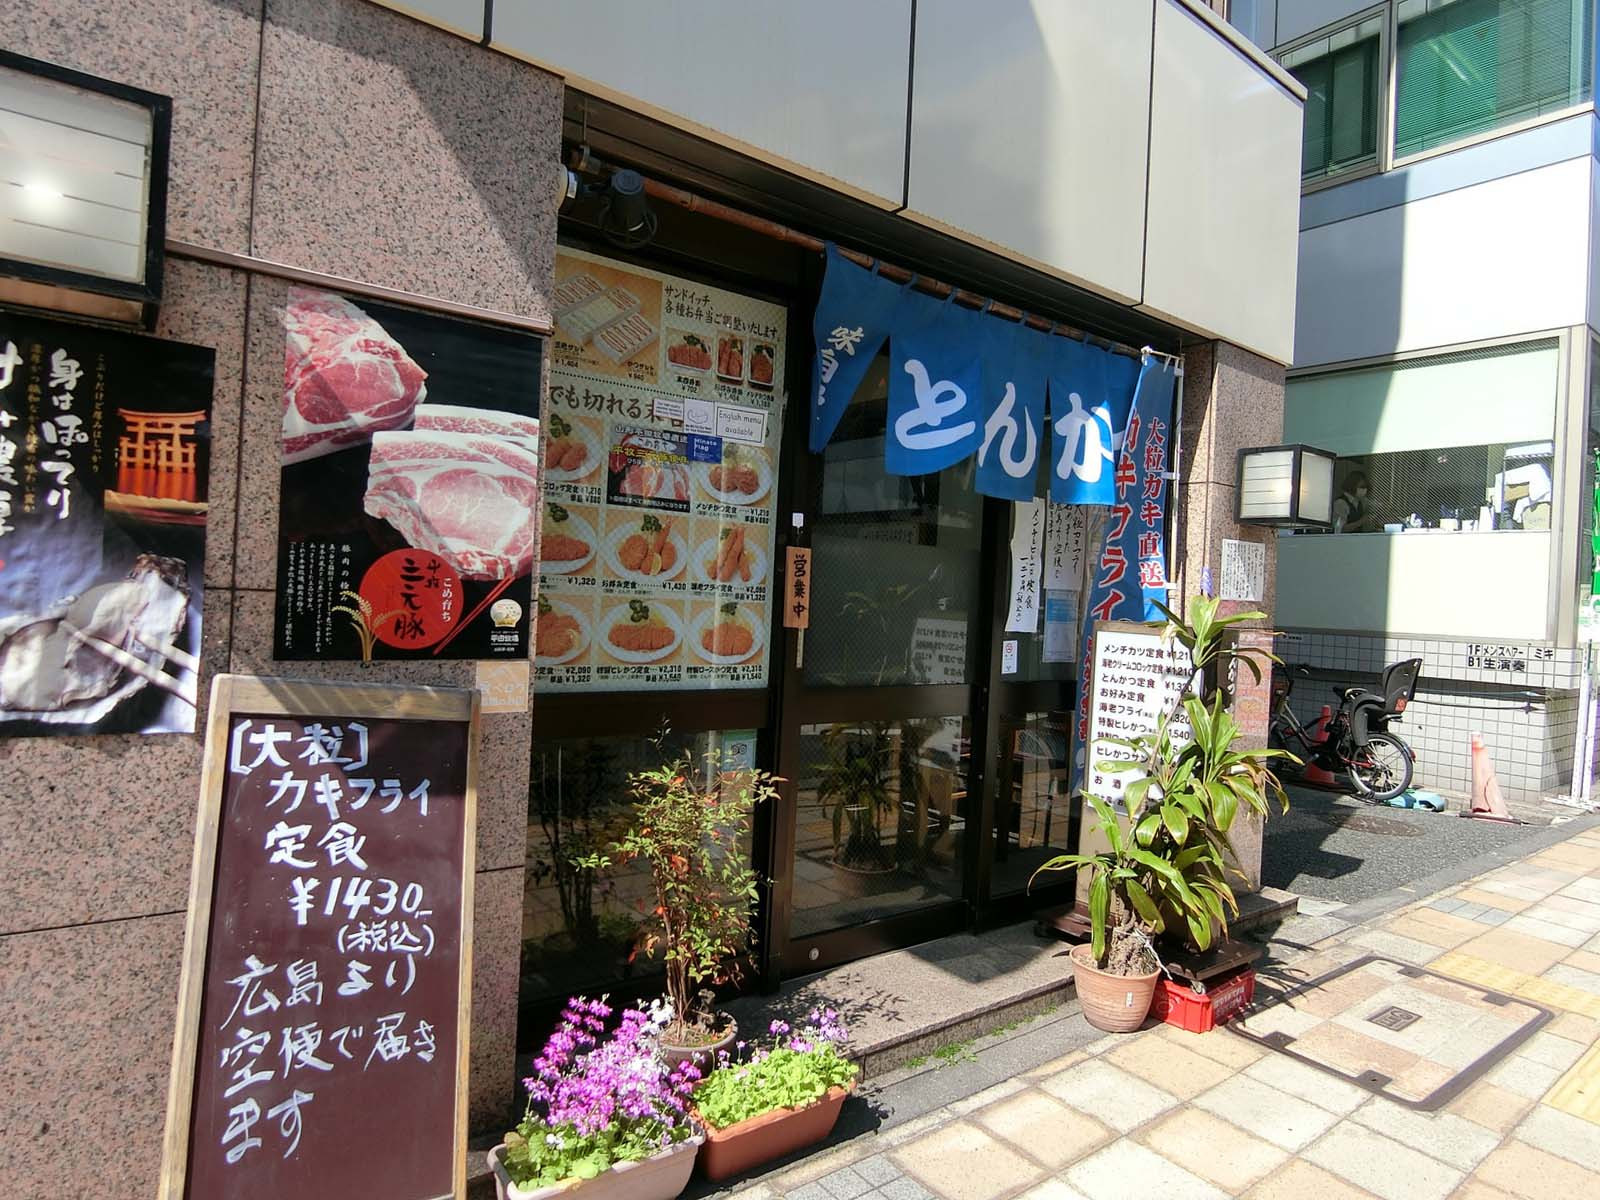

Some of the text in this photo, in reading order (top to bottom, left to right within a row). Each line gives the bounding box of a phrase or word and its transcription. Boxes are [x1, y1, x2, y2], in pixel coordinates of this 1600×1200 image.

[41, 347, 89, 520] 身はぽってり
[718, 409, 763, 426] English menu
[724, 425, 754, 437] available
[895, 359, 1126, 484] とんか
[1091, 408, 1141, 621] カキフライ
[1138, 416, 1167, 589] 大粒カキ直送
[394, 557, 426, 640] 三元豚
[441, 577, 454, 623] こめ育ち
[567, 576, 597, 587] ¥1,320
[601, 579, 638, 590] お好み定食
[792, 554, 807, 618] 営業中
[1101, 658, 1163, 675] 海老クリームコロッケ定食
[1102, 644, 1193, 662] メンチカツ定食 ¥1,21
[1468, 644, 1481, 655] 1F
[1534, 648, 1554, 660] ミキ
[1468, 656, 1526, 672] B1 生演奏
[1099, 687, 1145, 703] お好み定食
[1101, 673, 1156, 689] とんかつ定食
[265, 770, 432, 821] カキフライ
[264, 821, 368, 871] 定食
[337, 919, 435, 957] (税込)
[220, 953, 417, 1031] 広島より
[219, 1012, 437, 1098] 空便で届き
[221, 1089, 315, 1165] ます
